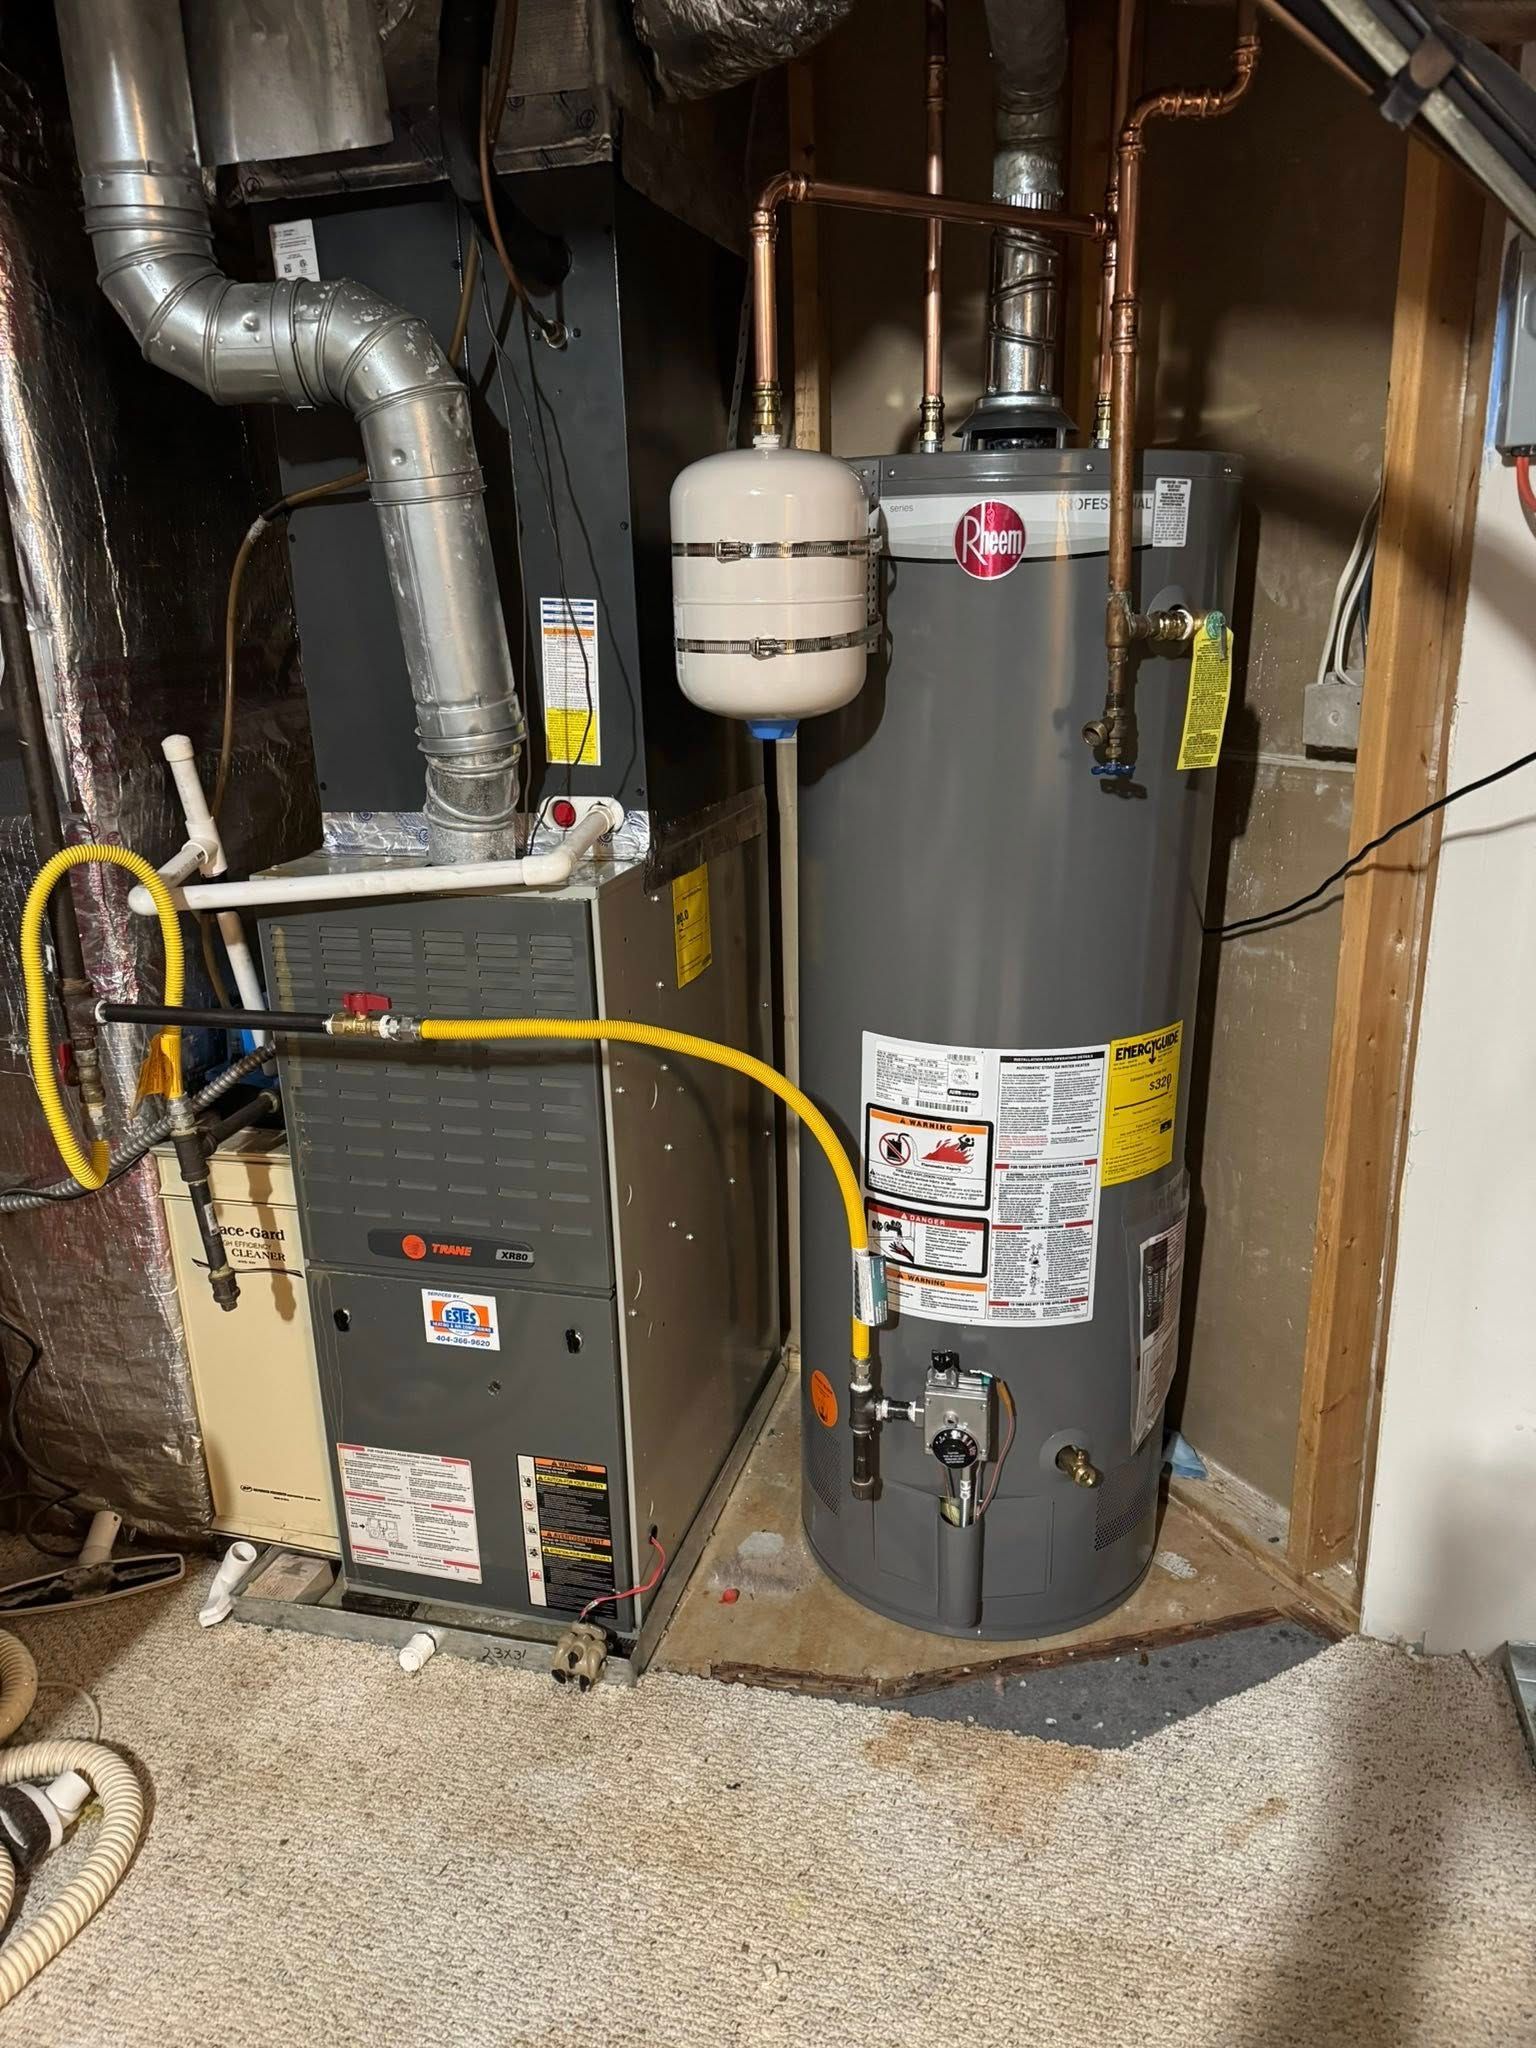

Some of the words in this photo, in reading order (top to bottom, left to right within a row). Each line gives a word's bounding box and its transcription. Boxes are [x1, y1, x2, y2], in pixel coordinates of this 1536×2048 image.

[889, 504, 914, 513] series
[961, 501, 1023, 566] Rheem
[909, 1119, 953, 1131] WARNING
[909, 1214, 946, 1226] DANGER
[219, 1225, 286, 1241] ace-Gard
[234, 1240, 272, 1250] EFFICIENCY
[431, 1243, 472, 1257] TRANE
[231, 1248, 286, 1262] CLEANER
[500, 1250, 528, 1261] XR80
[907, 1274, 946, 1287] WARNING
[445, 1307, 476, 1324] ESTES
[558, 1461, 588, 1470] WARNING
